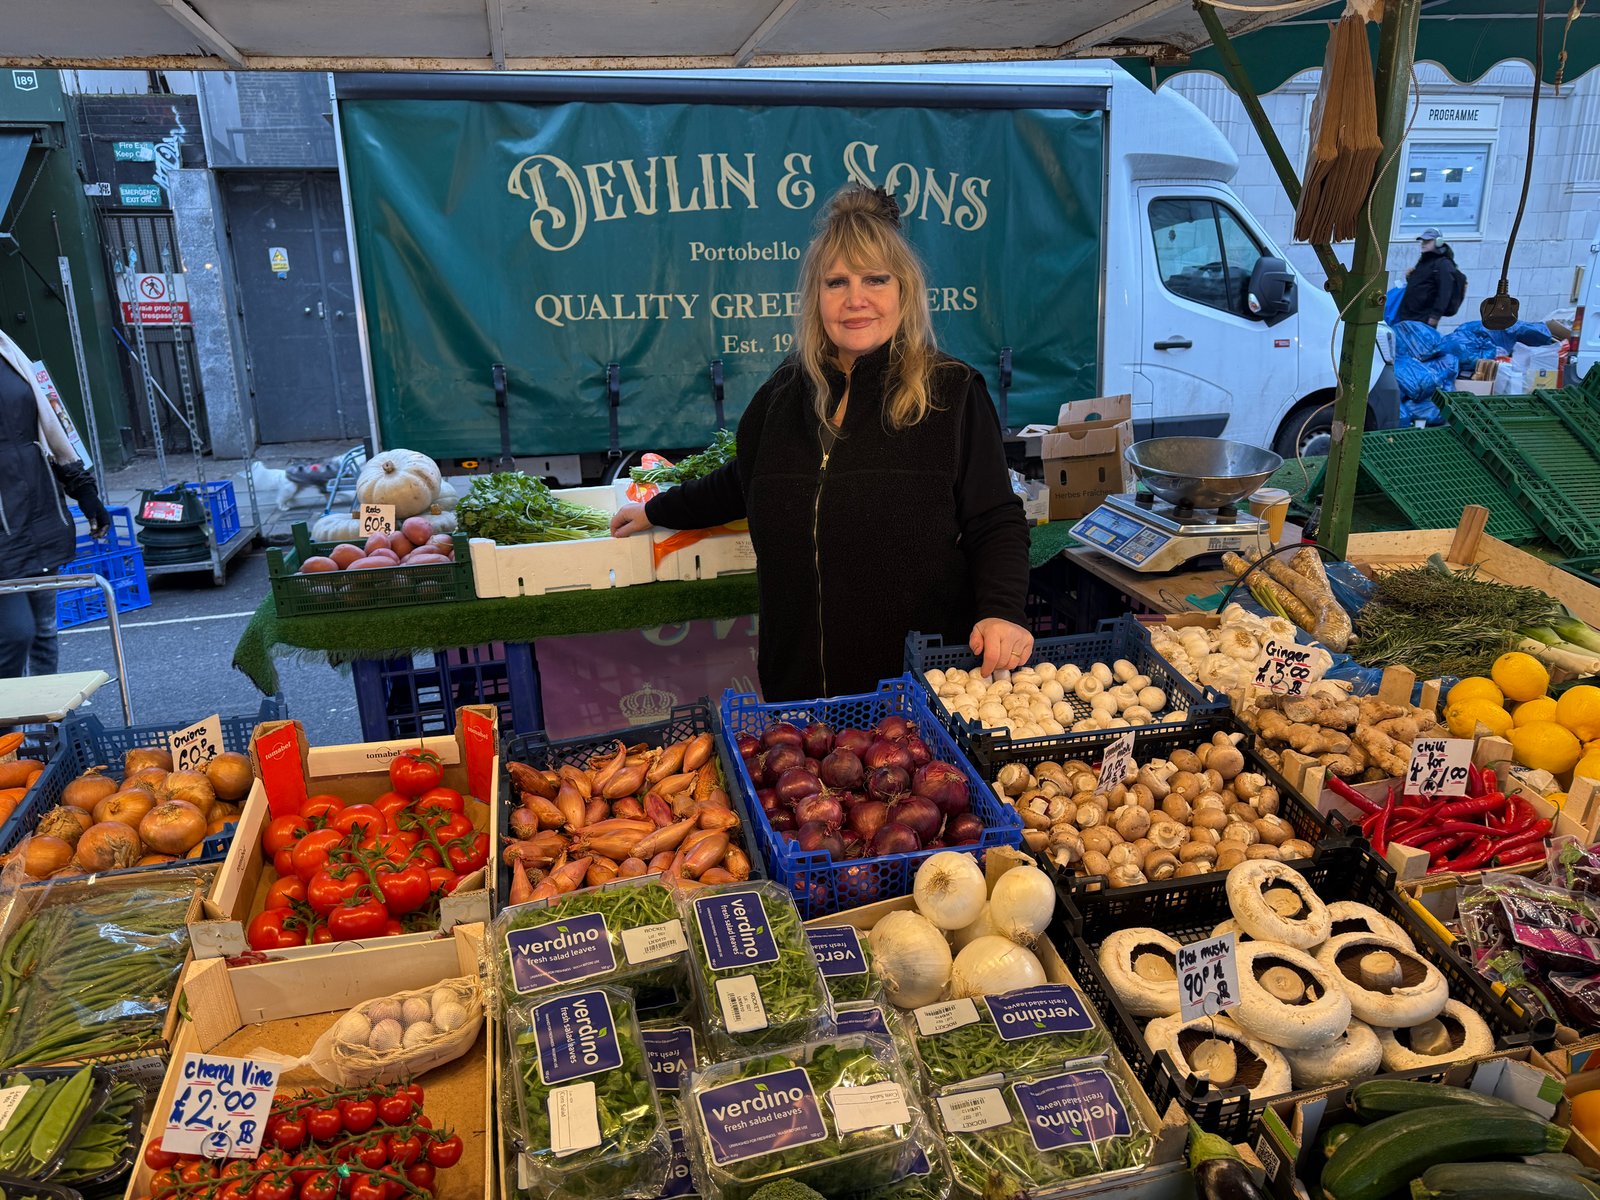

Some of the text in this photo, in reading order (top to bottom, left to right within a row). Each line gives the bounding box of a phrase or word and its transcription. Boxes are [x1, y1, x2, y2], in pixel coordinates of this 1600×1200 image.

[16, 76, 34, 86] 189
[1428, 109, 1479, 121] PROGRAMME
[115, 150, 134, 159] Keep
[120, 187, 160, 196] EMERGENCY
[777, 153, 816, 210] &
[126, 196, 140, 204] EXIT
[689, 241, 801, 261] Portobello
[535, 293, 699, 327] QUALITY
[722, 335, 764, 354] Est.
[1266, 641, 1311, 667] Ginger
[1255, 660, 1310, 685] £3.00
[174, 726, 207, 749] Onions
[1417, 741, 1447, 753] chilli
[264, 741, 292, 761] tomabel
[366, 749, 402, 760] tomabel
[1410, 757, 1424, 782] 4
[1427, 752, 1446, 771] for
[720, 904, 741, 956] fresh salad leaves
[731, 899, 759, 958] verdino
[518, 927, 600, 957] verdino
[829, 942, 847, 950] fresh
[1200, 940, 1230, 960] mush
[527, 945, 597, 967] fresh salad leaves
[749, 992, 761, 1014] ROCKET
[1003, 998, 1068, 1010] fresh salad leaves
[1003, 1006, 1080, 1025] verdino
[560, 1006, 577, 1064] fresh salad leaves
[572, 998, 599, 1066] verdino
[647, 1049, 681, 1059] fresh sal
[149, 1061, 162, 1069] Class
[184, 1058, 235, 1096] cherry
[242, 1060, 274, 1087] Vine
[169, 1086, 257, 1129] £2.00
[711, 1086, 804, 1122] verdino
[1037, 1092, 1104, 1111] fresh salad leaves
[724, 1107, 802, 1133] fresh salad leaves
[962, 1118, 988, 1129] ROCKET
[1037, 1102, 1118, 1128] verdino
